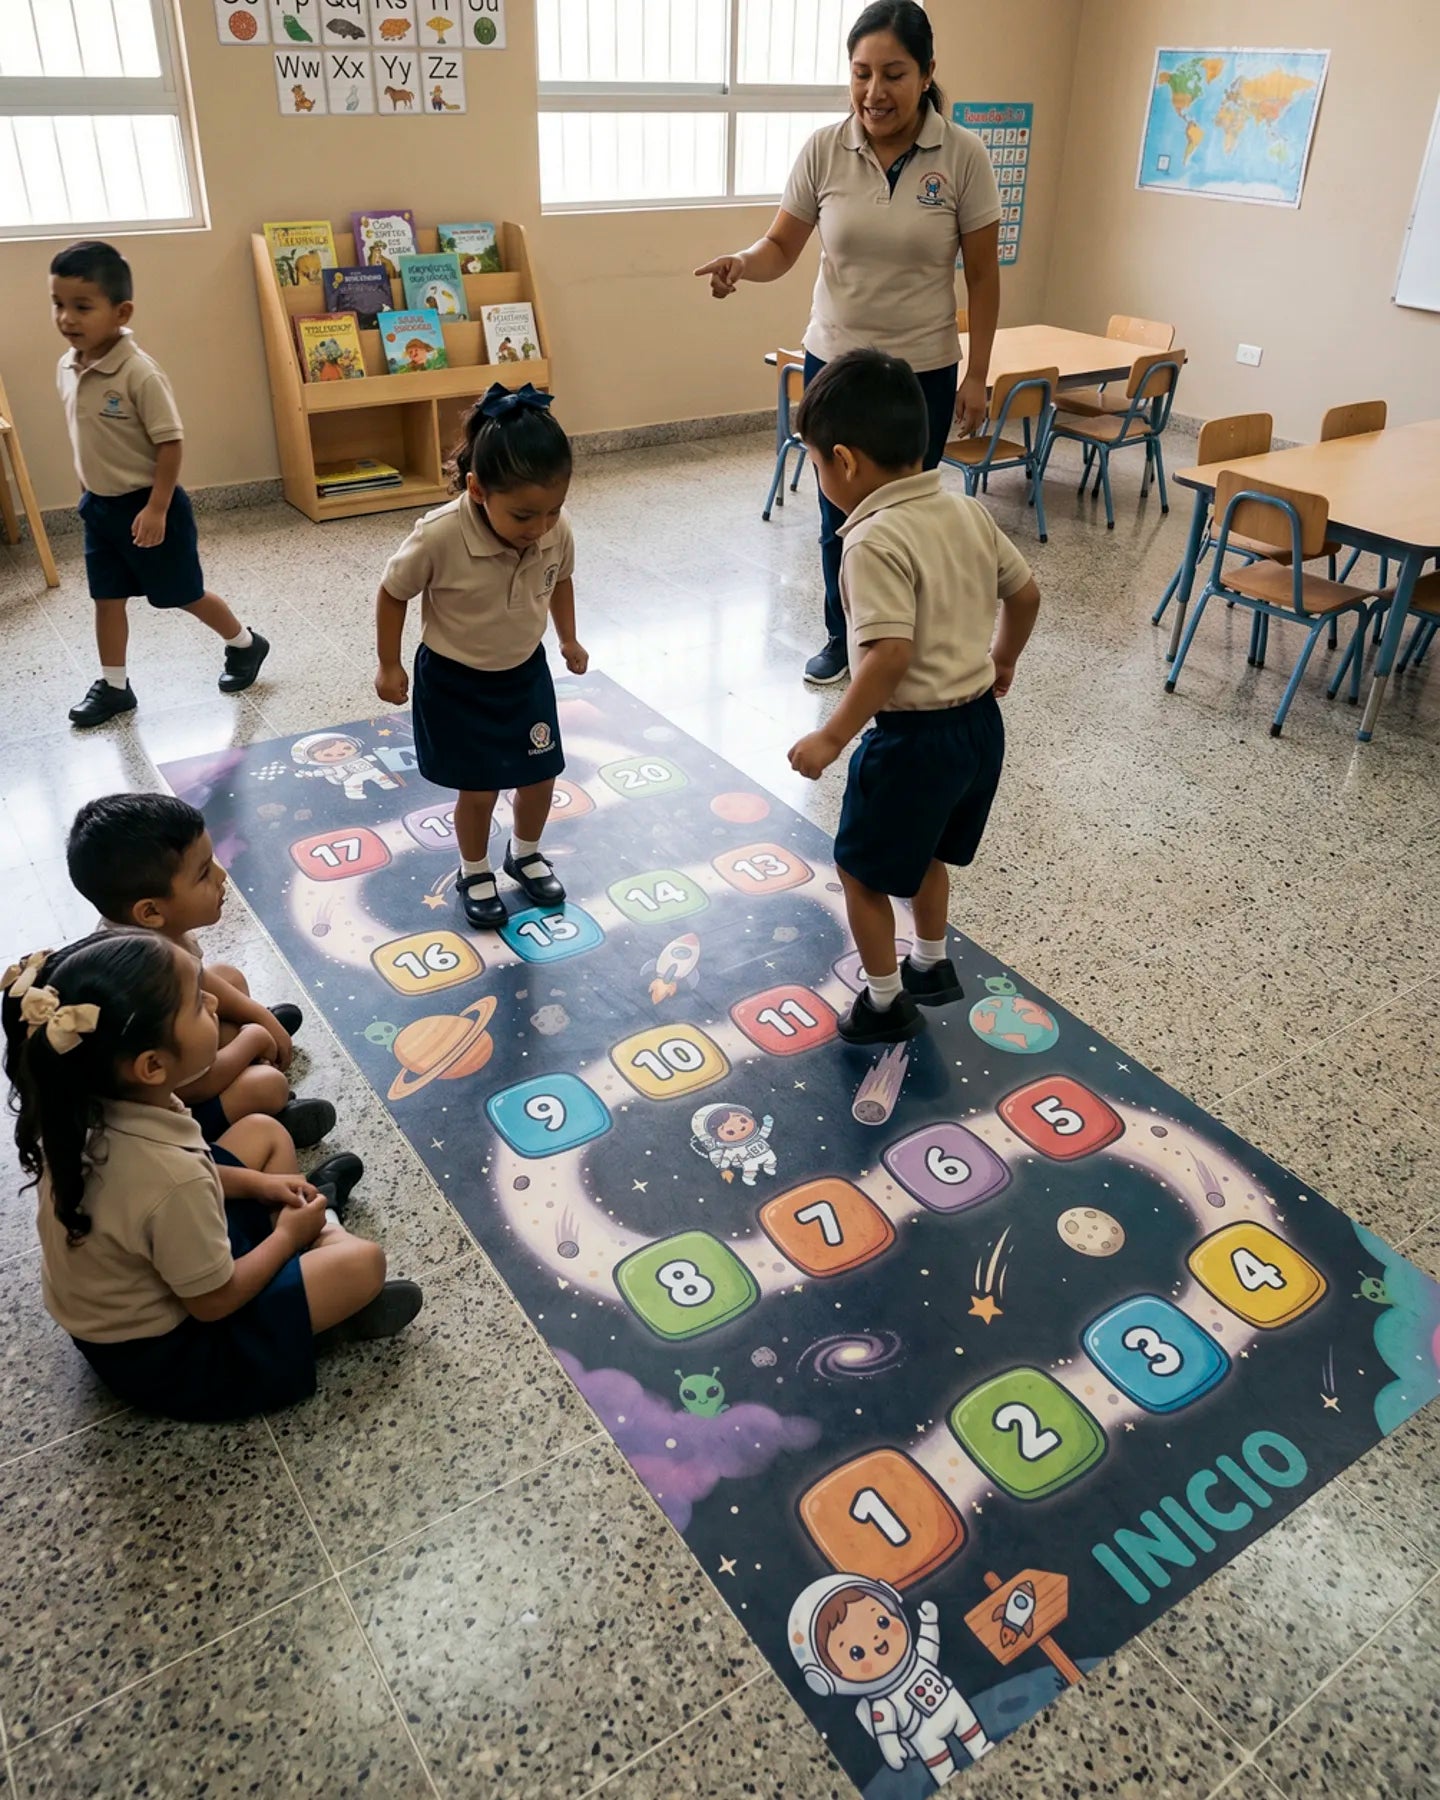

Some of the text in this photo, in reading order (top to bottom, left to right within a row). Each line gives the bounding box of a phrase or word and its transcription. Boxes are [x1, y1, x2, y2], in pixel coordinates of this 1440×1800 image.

[276, 55, 320, 79] Ww
[332, 55, 365, 79] Xx
[380, 55, 412, 85] Yy
[428, 56, 459, 79] Zz
[613, 763, 673, 790] 20
[420, 811, 456, 838] 1
[310, 836, 362, 867] 17
[733, 854, 790, 882] 13
[625, 880, 689, 912] 14
[517, 912, 580, 948] 15
[393, 942, 461, 980] 16
[757, 998, 820, 1037] 11
[631, 1037, 706, 1082] 10
[523, 1094, 567, 1133] 9
[1032, 1095, 1086, 1136] 5
[924, 1145, 972, 1186] 6
[793, 1199, 845, 1248] 7
[655, 1258, 714, 1308] 8
[1229, 1246, 1287, 1293] 4
[1121, 1325, 1185, 1377] 3
[991, 1401, 1064, 1463] 2
[848, 1486, 912, 1547] 1
[1091, 1430, 1308, 1606] INICIO
